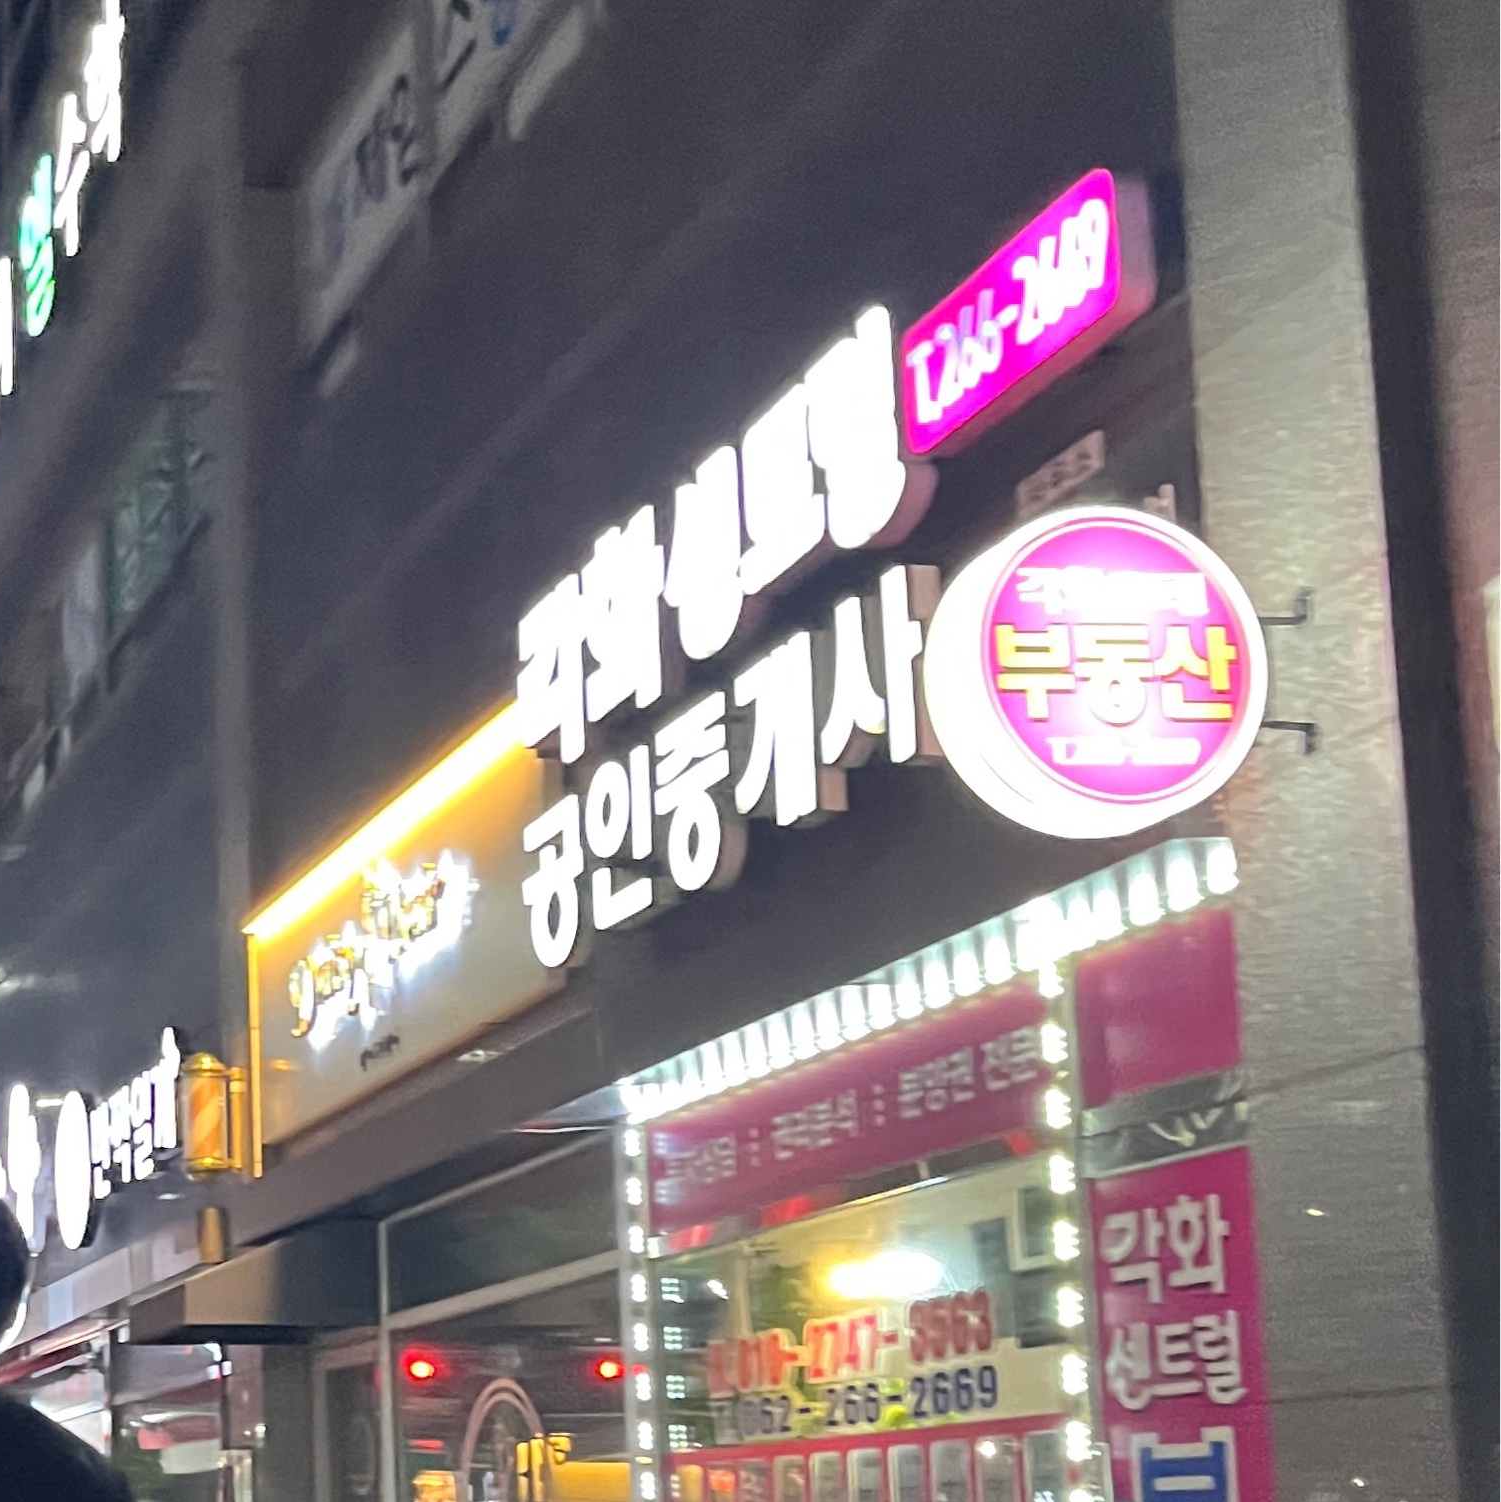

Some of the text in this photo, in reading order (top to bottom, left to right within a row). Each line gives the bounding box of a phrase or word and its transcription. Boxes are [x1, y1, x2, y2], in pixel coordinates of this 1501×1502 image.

[995, 621, 1237, 727] 부동산
[522, 564, 923, 967] 공인중개사
[900, 1047, 976, 1120] 분양권
[981, 1026, 1038, 1091] 전문
[1101, 1193, 1230, 1303] 각화
[1106, 1310, 1248, 1411] 센트럴
